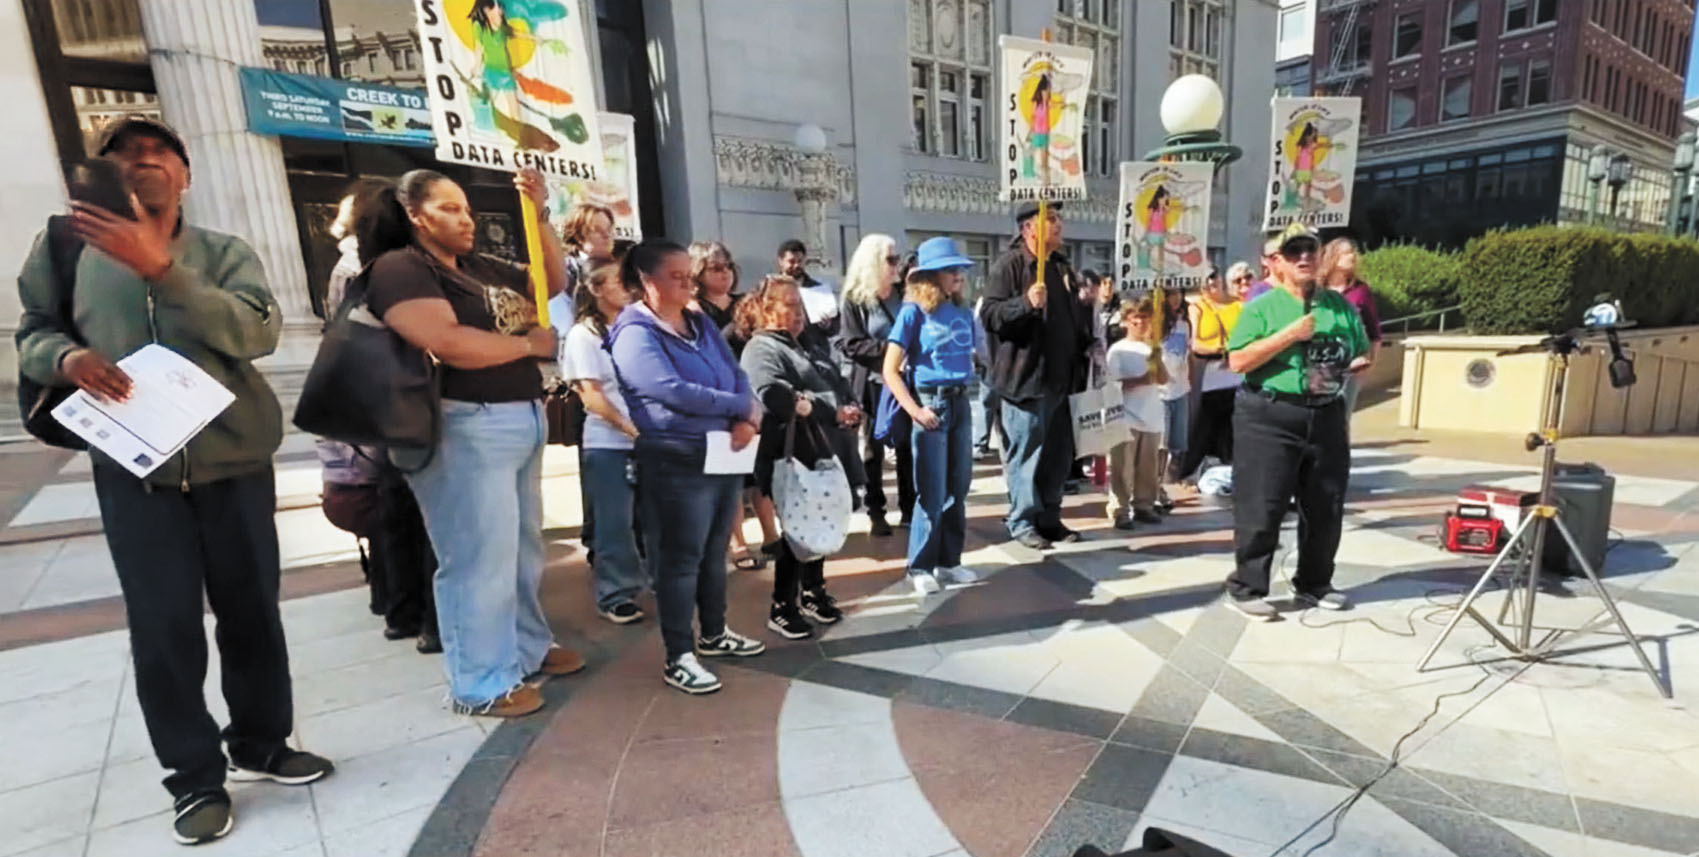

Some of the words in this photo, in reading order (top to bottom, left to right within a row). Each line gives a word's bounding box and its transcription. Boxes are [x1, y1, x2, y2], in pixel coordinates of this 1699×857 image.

[421, 0, 462, 136] STOP
[272, 101, 324, 114] SEPTEMBER
[346, 87, 399, 106] CREEK
[400, 94, 421, 108] TO
[1009, 93, 1018, 186] STOP
[452, 142, 504, 166] DATA
[513, 151, 597, 181] CENTERS!
[1271, 139, 1282, 214] STOP
[1010, 188, 1035, 201] DATA
[1121, 202, 1132, 278] STOP
[1121, 279, 1148, 291] DATA
